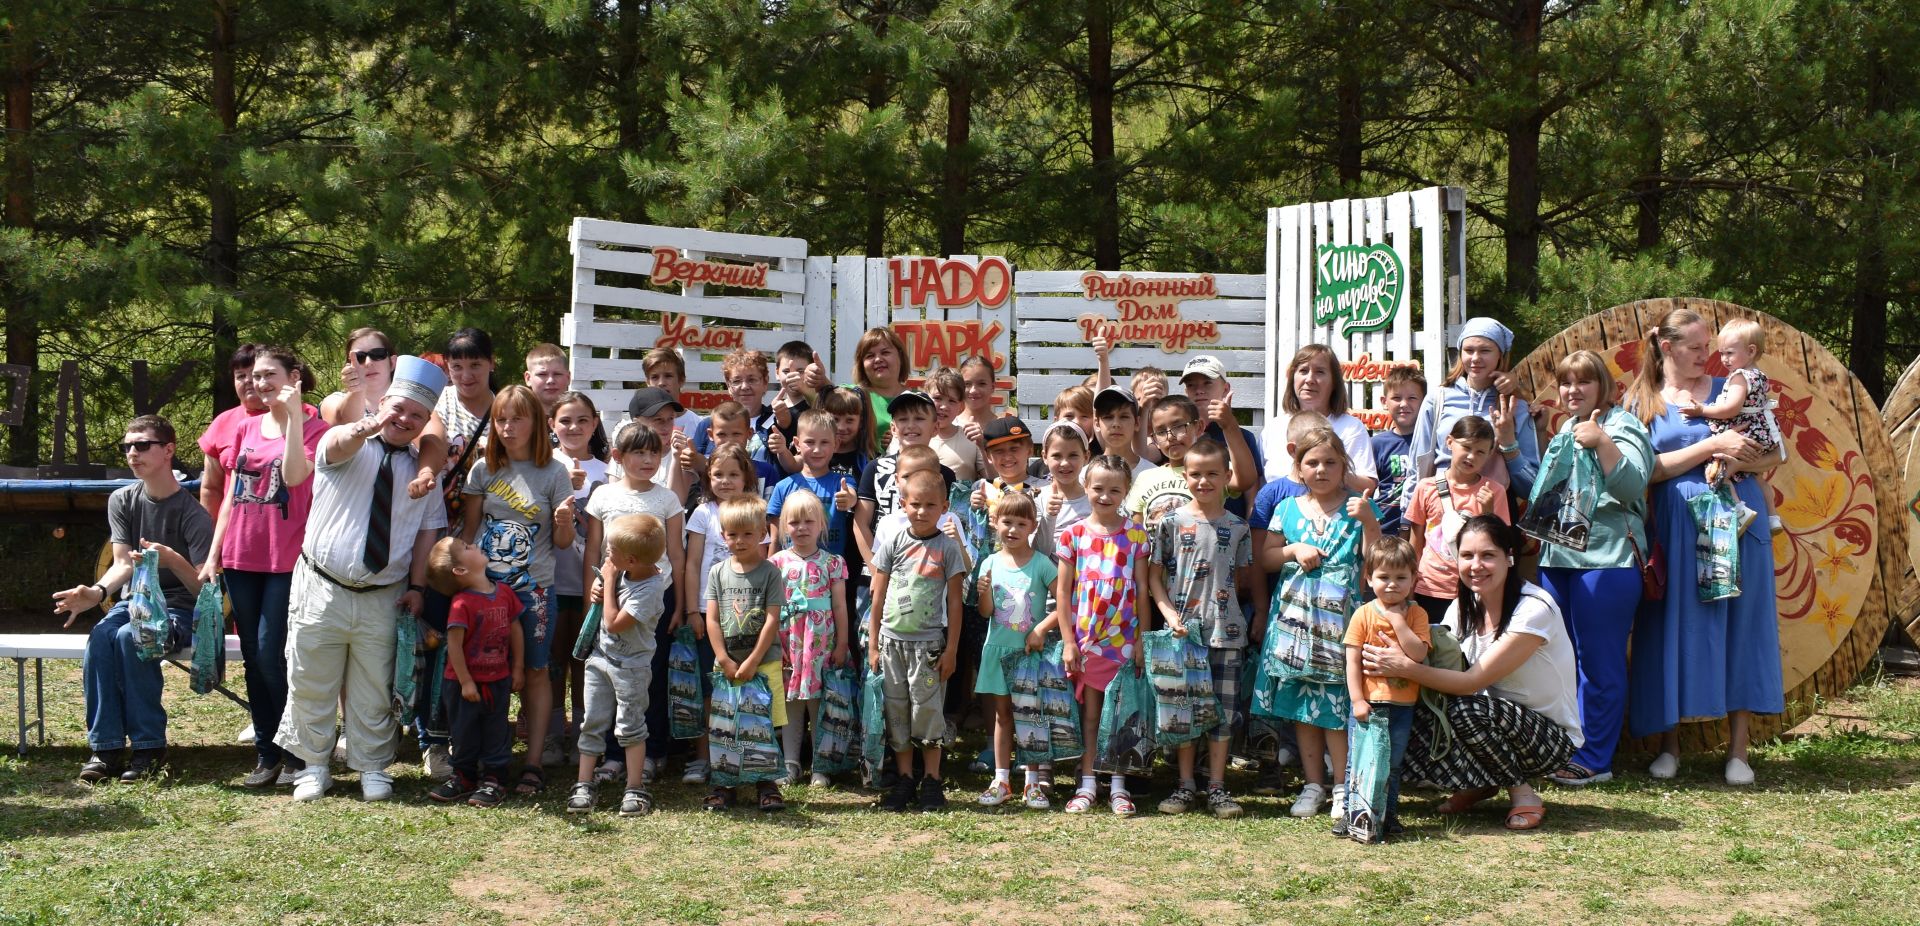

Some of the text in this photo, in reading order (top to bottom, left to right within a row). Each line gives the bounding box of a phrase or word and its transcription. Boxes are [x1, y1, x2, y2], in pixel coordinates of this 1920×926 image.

[652, 247, 768, 288] Верхний
[1317, 247, 1369, 286] Кино
[1083, 275, 1216, 298] Районный
[1316, 269, 1386, 320] на траве
[1117, 300, 1178, 322] Дом
[655, 313, 744, 349] Услон
[1080, 318, 1218, 349] Культуры
[487, 479, 541, 520] JUNGLE
[1141, 480, 1189, 502] ADVENTU
